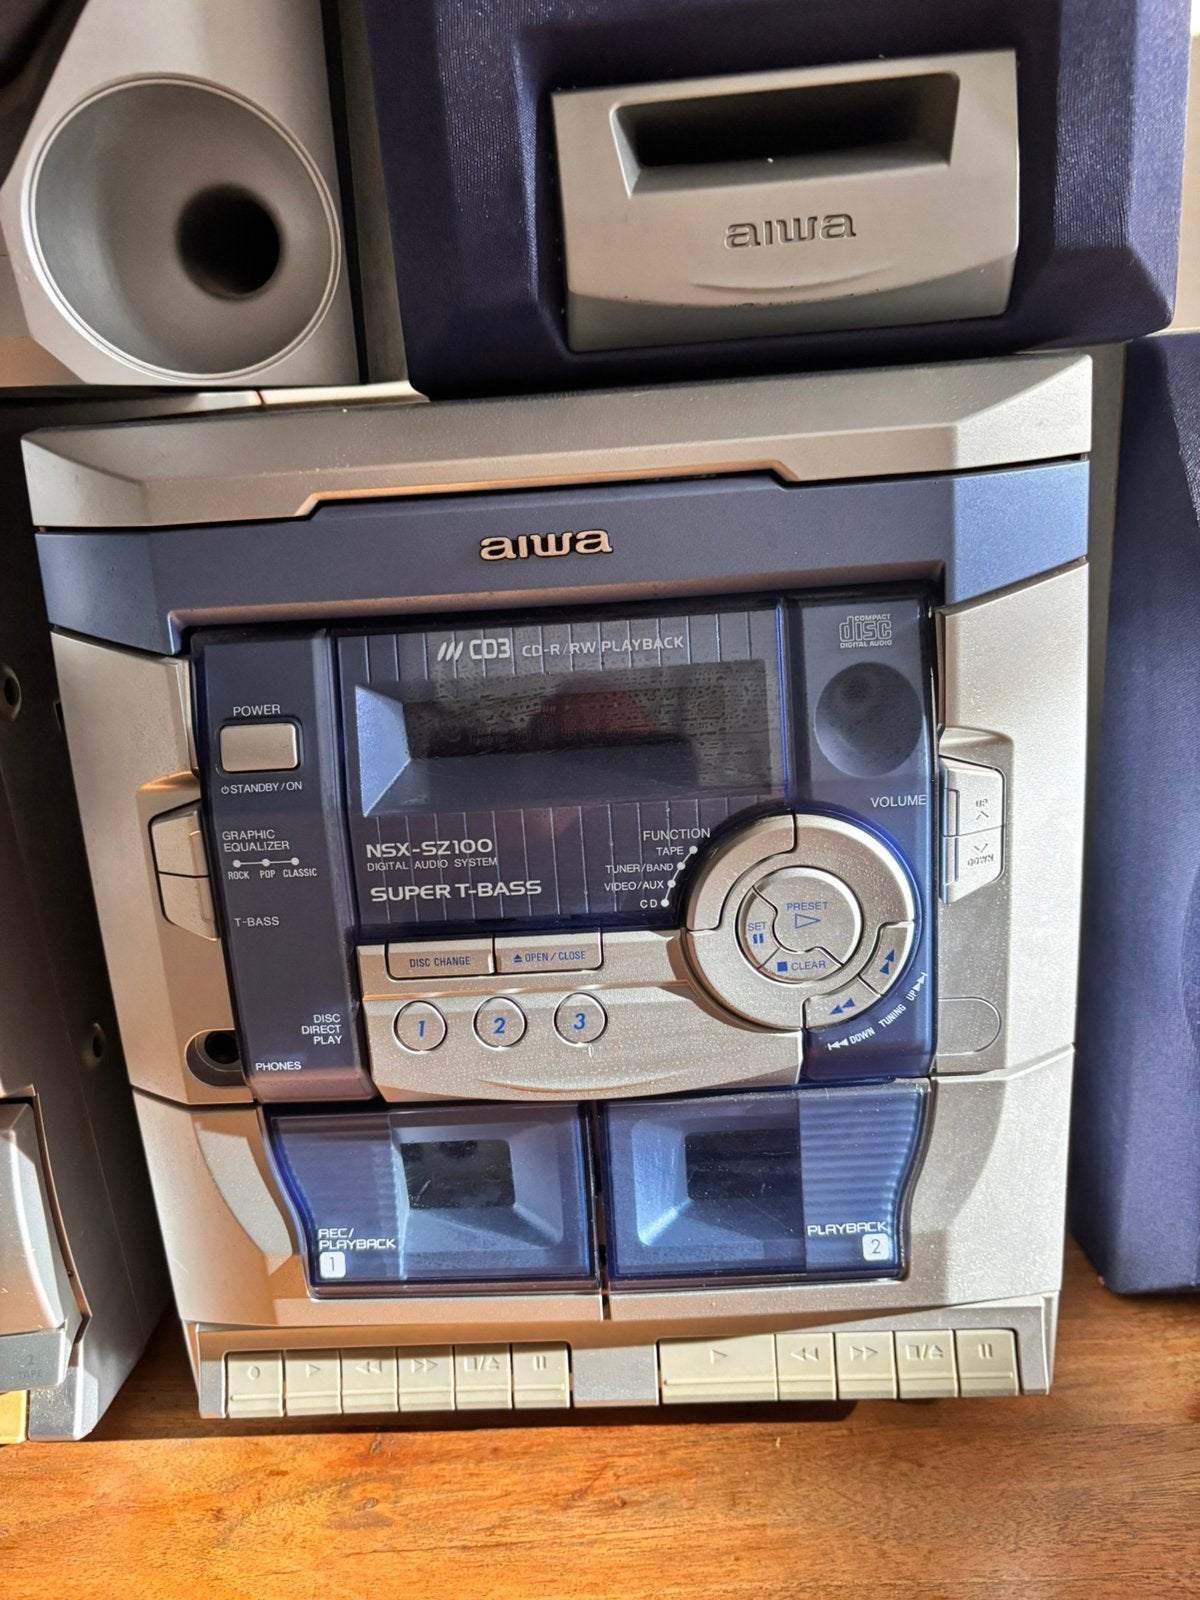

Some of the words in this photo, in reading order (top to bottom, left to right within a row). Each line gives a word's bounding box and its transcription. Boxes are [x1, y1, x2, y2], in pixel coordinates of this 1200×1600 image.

[725, 212, 857, 250] aiwa
[479, 528, 613, 562] aiwa
[854, 613, 892, 621] COMPACT
[522, 640, 596, 657] CD-R/RW
[601, 635, 684, 654] PLAYBACK
[233, 704, 281, 717] POWER
[870, 794, 927, 808] VOLUME
[222, 830, 275, 841] GRAPHIC
[643, 828, 711, 842] FUNCTION
[224, 841, 290, 853] EQUALIZER
[366, 839, 493, 859] NSX-SZ100
[656, 846, 684, 856] TAPE
[367, 860, 409, 871] DIGITAL
[414, 859, 449, 870] AUDIO
[454, 857, 498, 868] SYSTEM
[605, 863, 674, 874] TUNER/BAND
[228, 868, 250, 880] ROCK
[259, 868, 276, 879] POP
[283, 866, 318, 878] CLASSIC
[370, 885, 451, 902] SUPER
[456, 880, 542, 899] T-BASS
[604, 880, 664, 892] VIDEO/AUX
[786, 901, 829, 912] PRESET
[234, 916, 280, 927] T-BASS
[747, 921, 768, 932] SET
[409, 957, 430, 969] DISC
[433, 956, 471, 967] CHANGE
[791, 959, 827, 972] CLEAR
[907, 988, 918, 1001] UP
[313, 1013, 341, 1024] DISC
[573, 1012, 586, 1032] 3
[878, 1003, 907, 1029] TUNING
[301, 1024, 342, 1035] DIRECT
[417, 1020, 427, 1038] 1
[493, 1016, 506, 1036] 2
[313, 1035, 343, 1046] PLAY
[849, 1026, 876, 1045] DOWN
[255, 1060, 302, 1072] PHONES
[319, 1228, 354, 1238] REC/
[807, 1221, 887, 1236] PLAYBACK
[318, 1238, 396, 1250] PLAYBACK
[870, 1239, 881, 1254] 2
